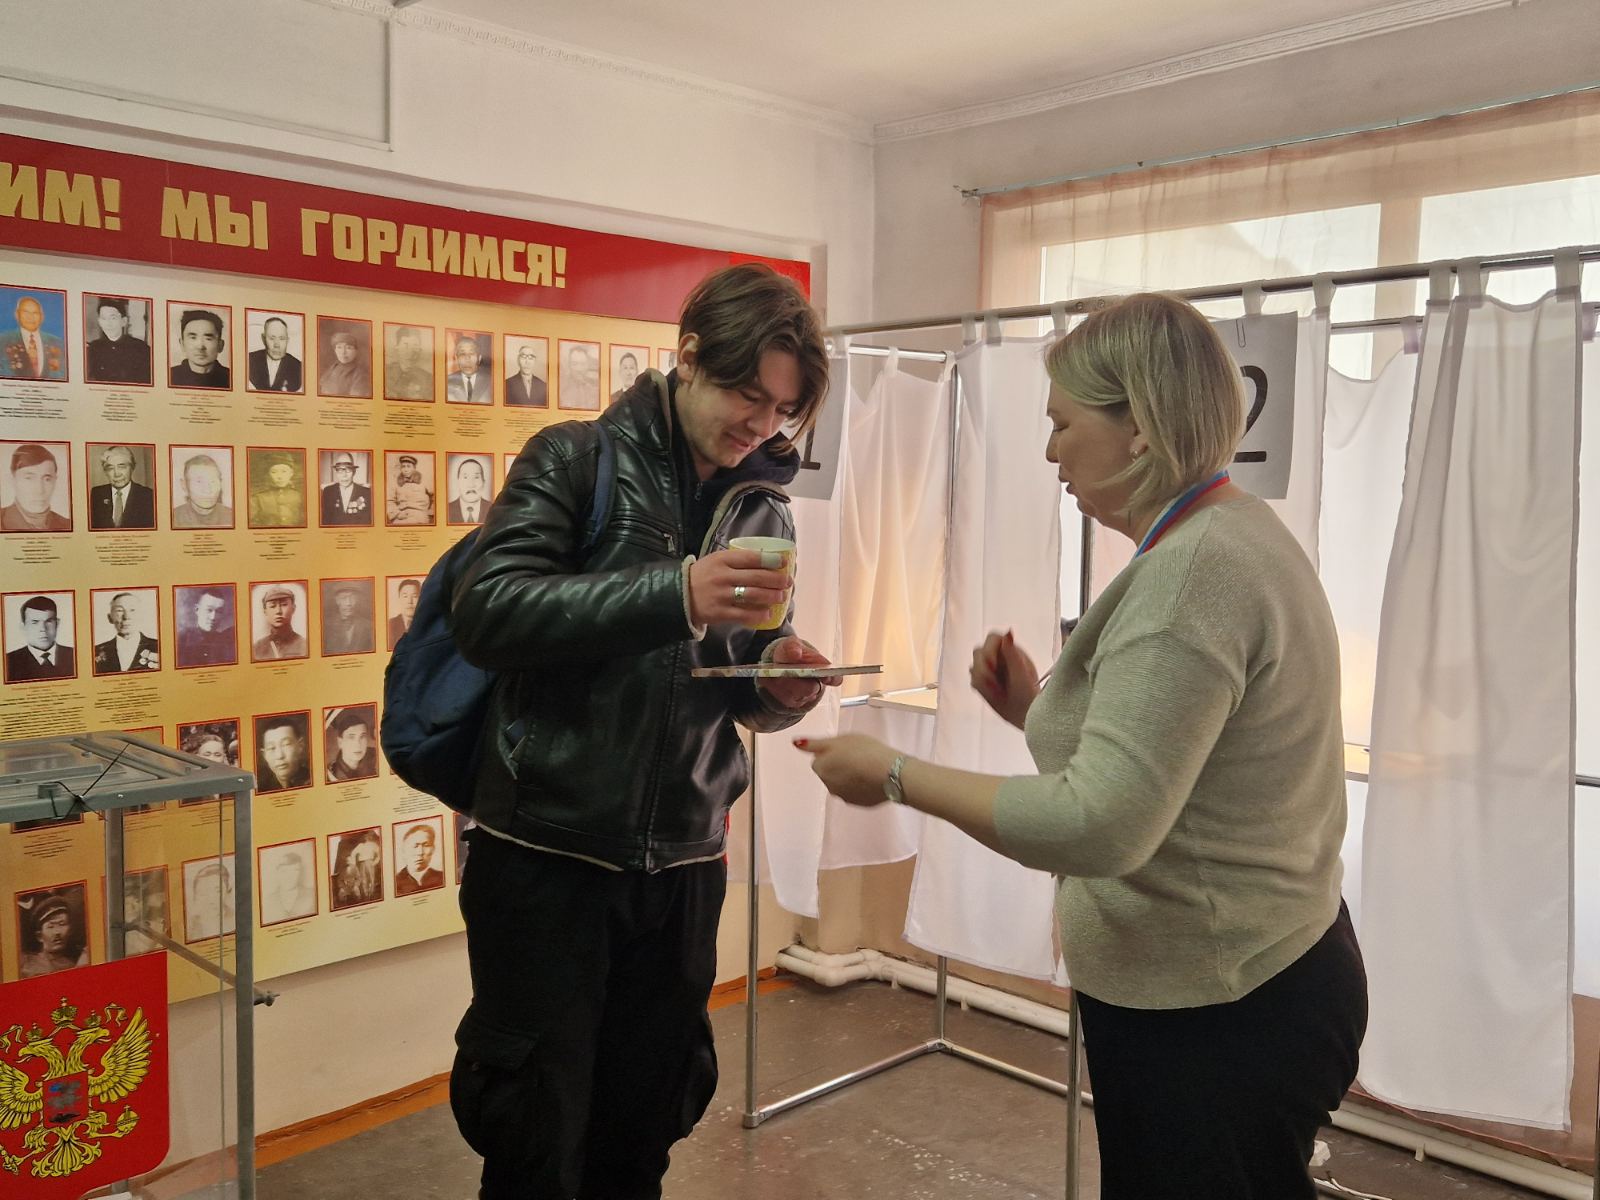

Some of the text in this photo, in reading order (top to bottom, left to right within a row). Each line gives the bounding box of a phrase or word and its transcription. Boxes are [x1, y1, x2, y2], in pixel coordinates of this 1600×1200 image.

[0, 162, 567, 289] ИМ! МЫ ГОРДИМСЯ!
[1233, 365, 1268, 463] 2
